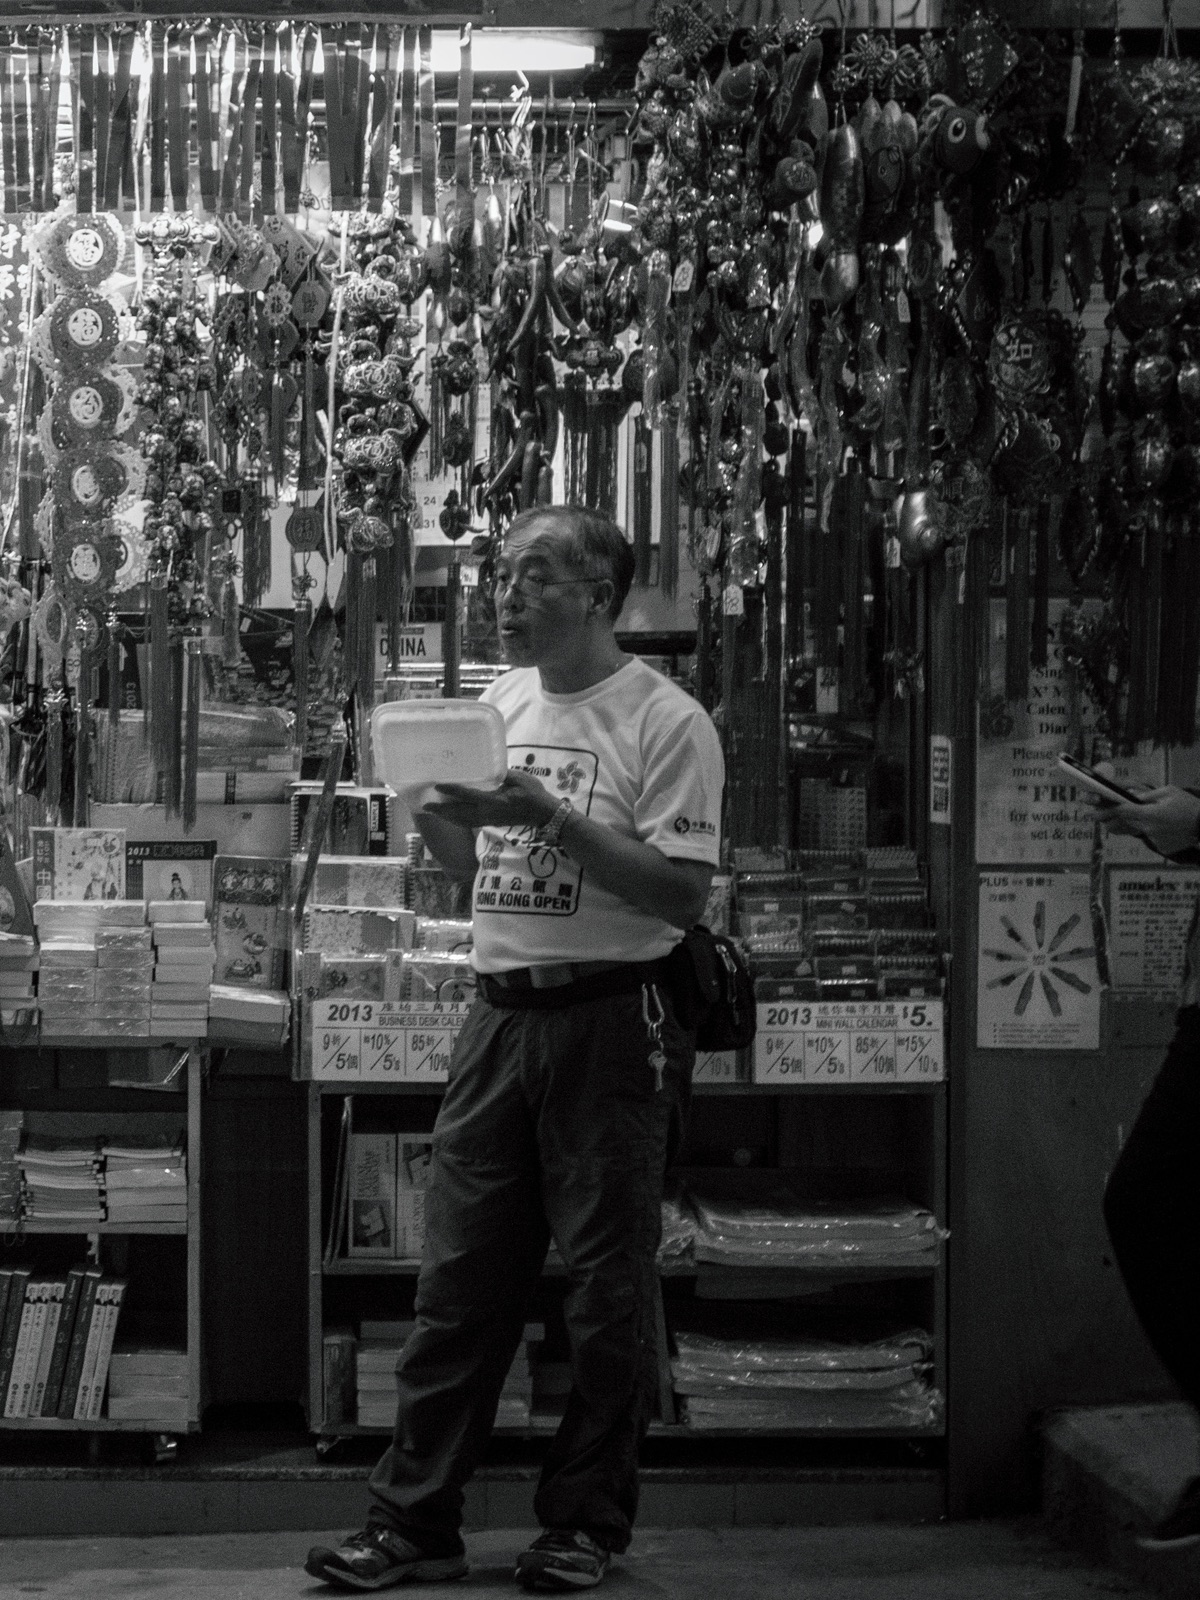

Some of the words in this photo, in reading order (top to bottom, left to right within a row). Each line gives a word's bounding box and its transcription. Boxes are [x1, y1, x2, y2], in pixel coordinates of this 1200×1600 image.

[423, 496, 437, 506] 24
[379, 637, 427, 657] CINA
[127, 846, 151, 856] 2013
[980, 876, 1010, 888] PLUS
[499, 892, 531, 908] KONG
[533, 894, 572, 911] OPEN
[327, 1003, 373, 1022] 2013
[765, 1007, 813, 1027] 2013
[378, 1015, 418, 1027] BUSINESS
[419, 1016, 439, 1027] DESK
